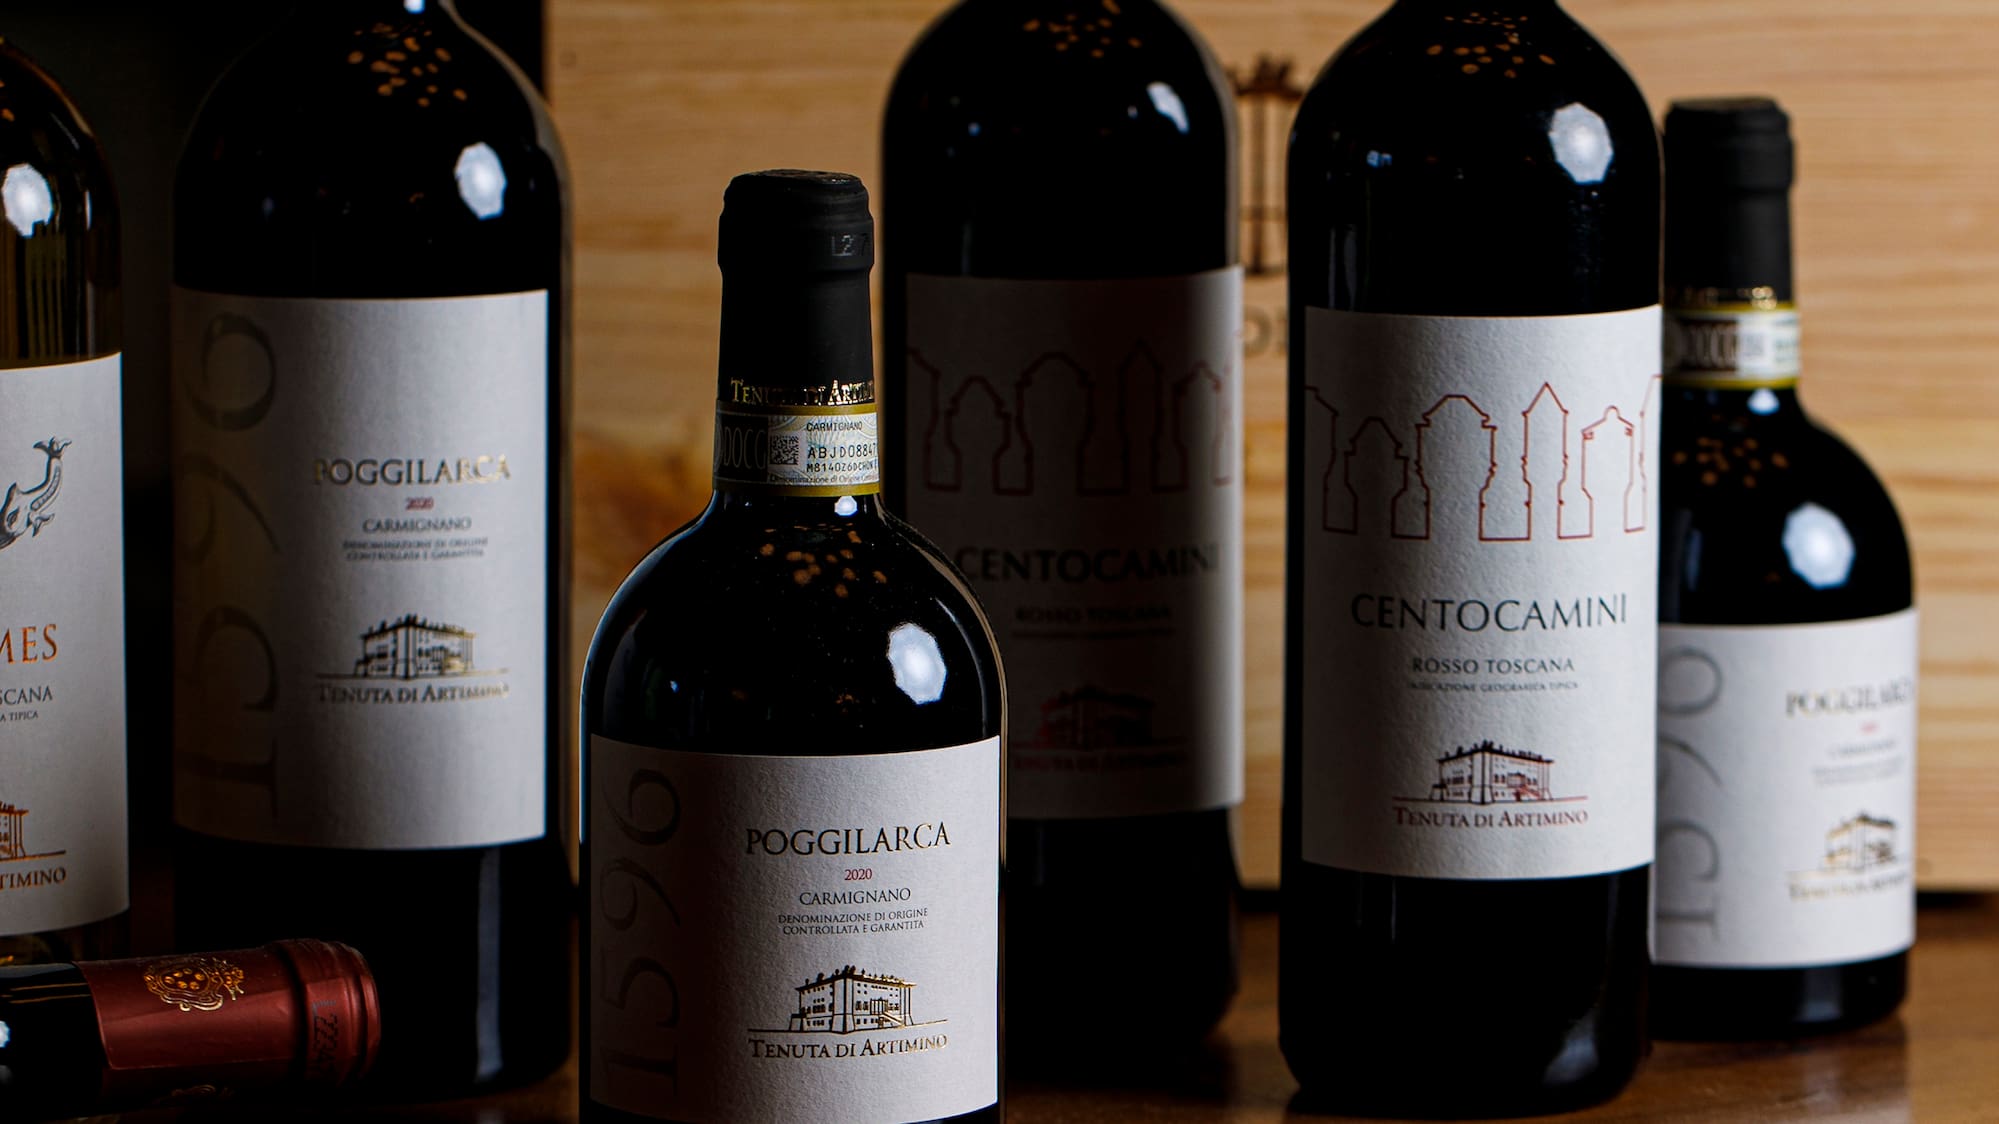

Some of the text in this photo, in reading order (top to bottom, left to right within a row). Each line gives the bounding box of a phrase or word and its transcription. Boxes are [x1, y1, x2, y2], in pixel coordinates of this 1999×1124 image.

[806, 421, 864, 432] CARMIGNANO
[312, 453, 511, 486] POGGILARCA
[362, 517, 472, 534] CARMIGNANO
[1351, 593, 1628, 632] CENTOCAMINI
[1411, 656, 1576, 674] ROSSO TOSCANA
[318, 683, 393, 703] TENUTA
[399, 688, 419, 702] DI
[9, 710, 39, 721] TIPICA
[1392, 806, 1589, 828] TENUTA DI ARTIMINO
[746, 821, 951, 856] POGGILARCA
[844, 868, 873, 881] 2020
[799, 887, 912, 906] CARMIGNANO
[778, 907, 928, 924] DENOMINAZIONE DI ORIGINE
[600, 767, 682, 1098] 1596
[783, 920, 924, 936] CONTROLLATA E GARANTITA
[748, 1033, 948, 1059] TENUTA DI ARTIMINO
